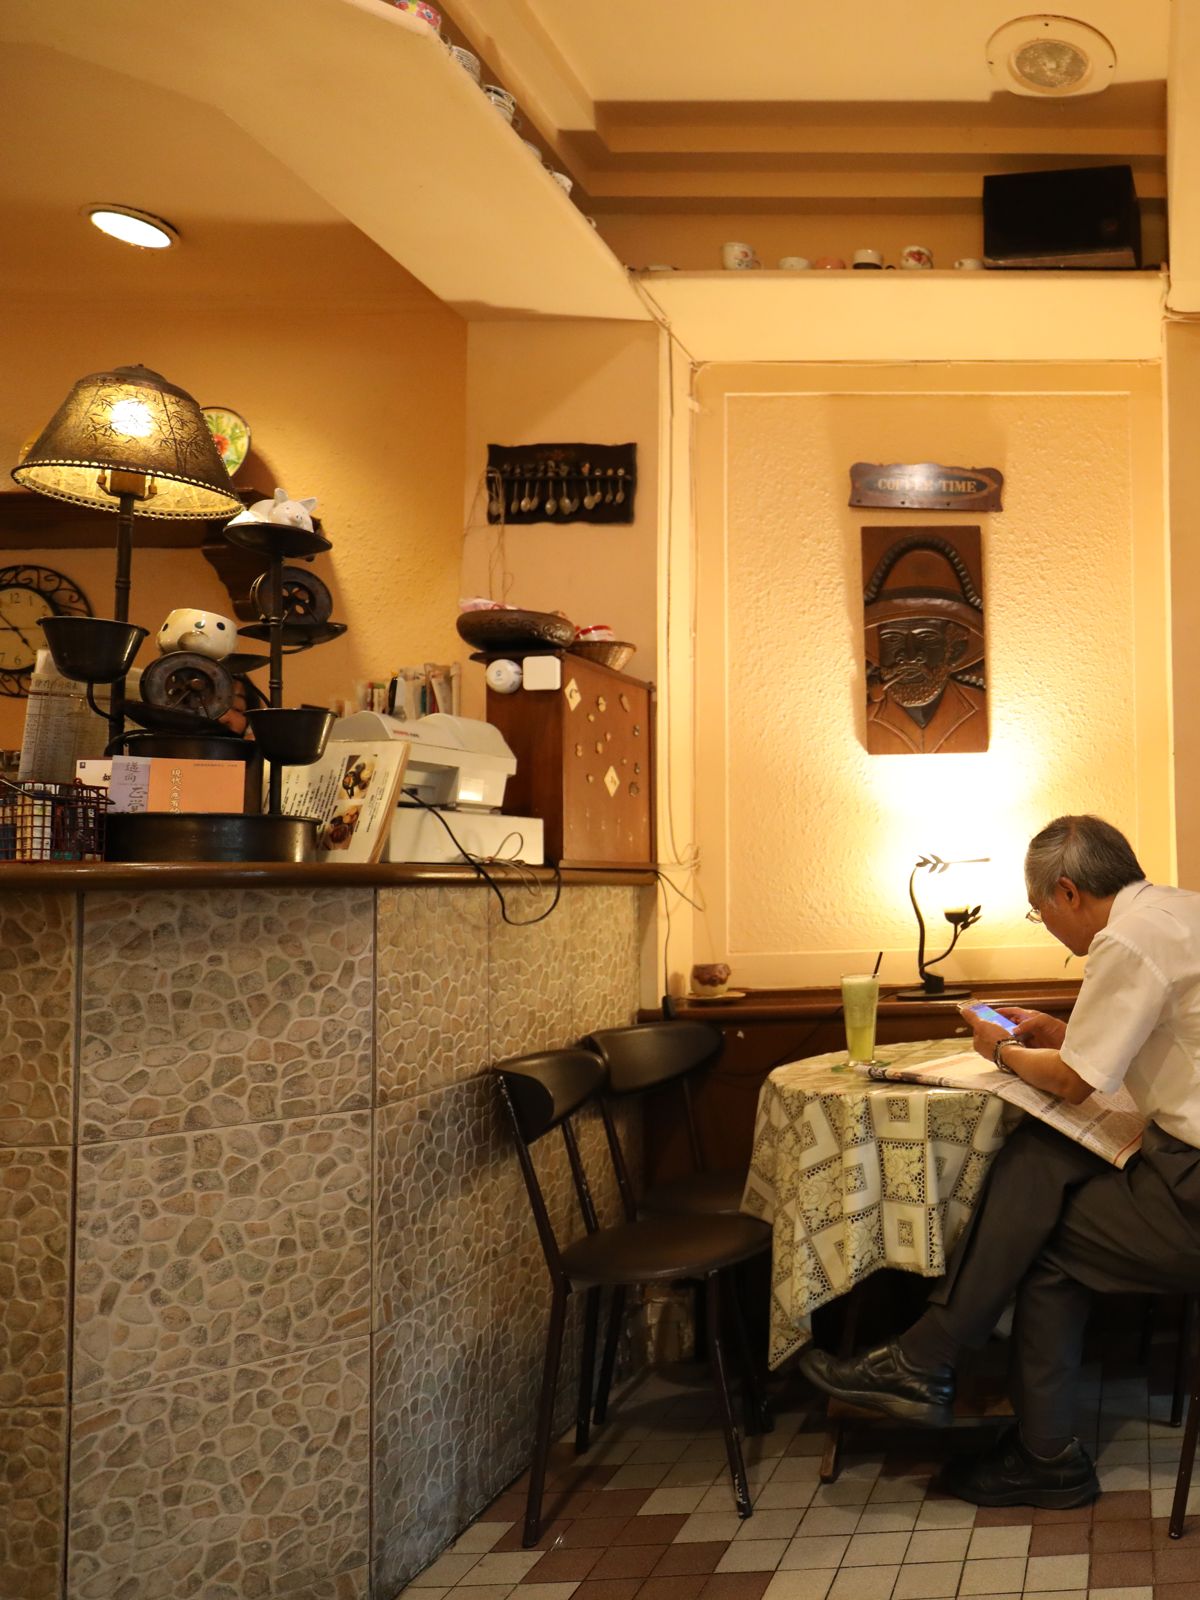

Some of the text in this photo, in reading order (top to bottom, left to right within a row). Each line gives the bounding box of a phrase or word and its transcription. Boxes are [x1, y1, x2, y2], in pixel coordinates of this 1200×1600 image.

[877, 478, 977, 493] COFFEE TIME
[9, 592, 20, 604] 12
